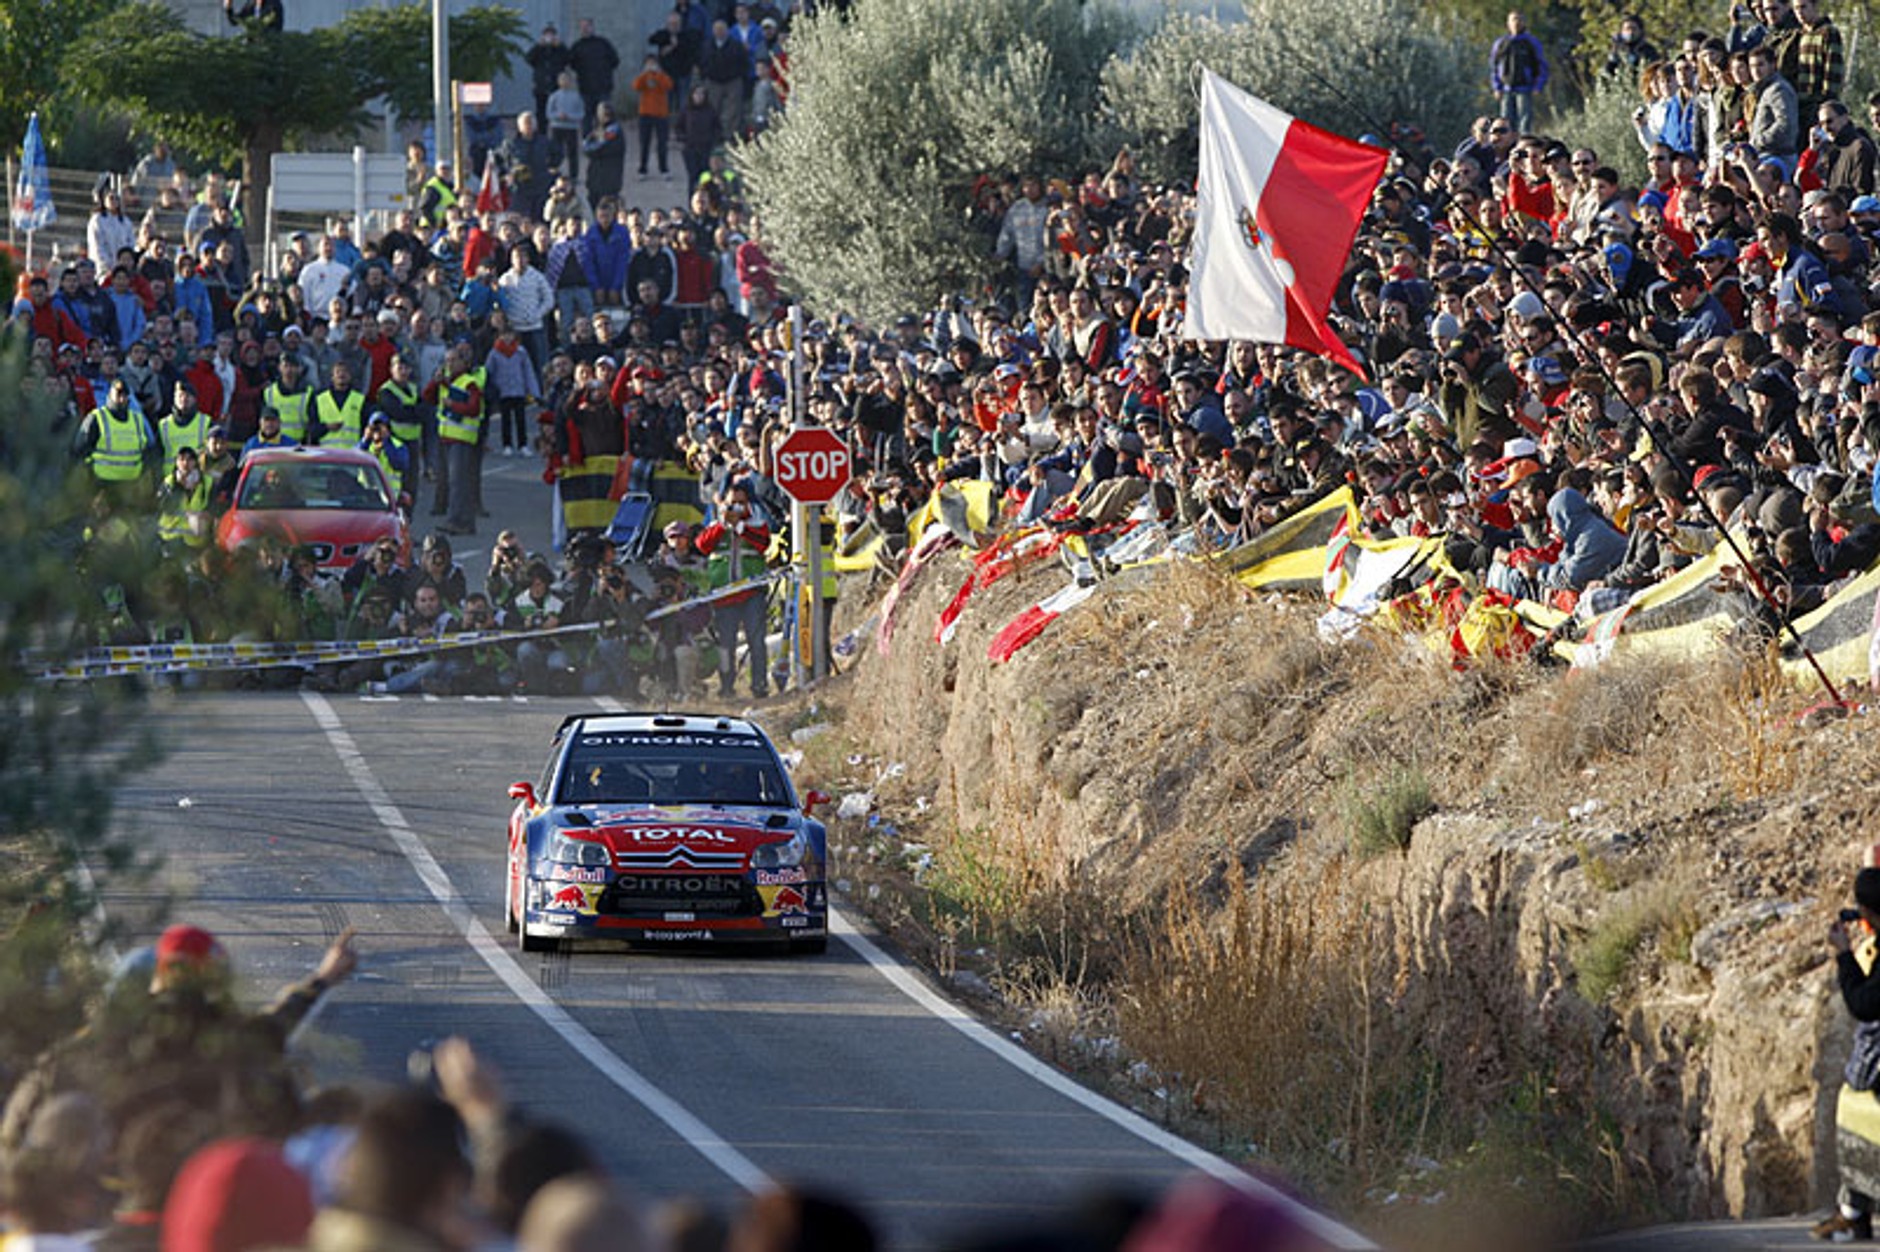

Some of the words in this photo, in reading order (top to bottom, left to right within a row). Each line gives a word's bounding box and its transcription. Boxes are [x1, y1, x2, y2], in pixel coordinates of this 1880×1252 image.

[780, 450, 847, 482] STOP
[582, 735, 714, 747] CITROËN
[624, 826, 735, 843] TOTAL
[617, 875, 741, 892] CITROËN
